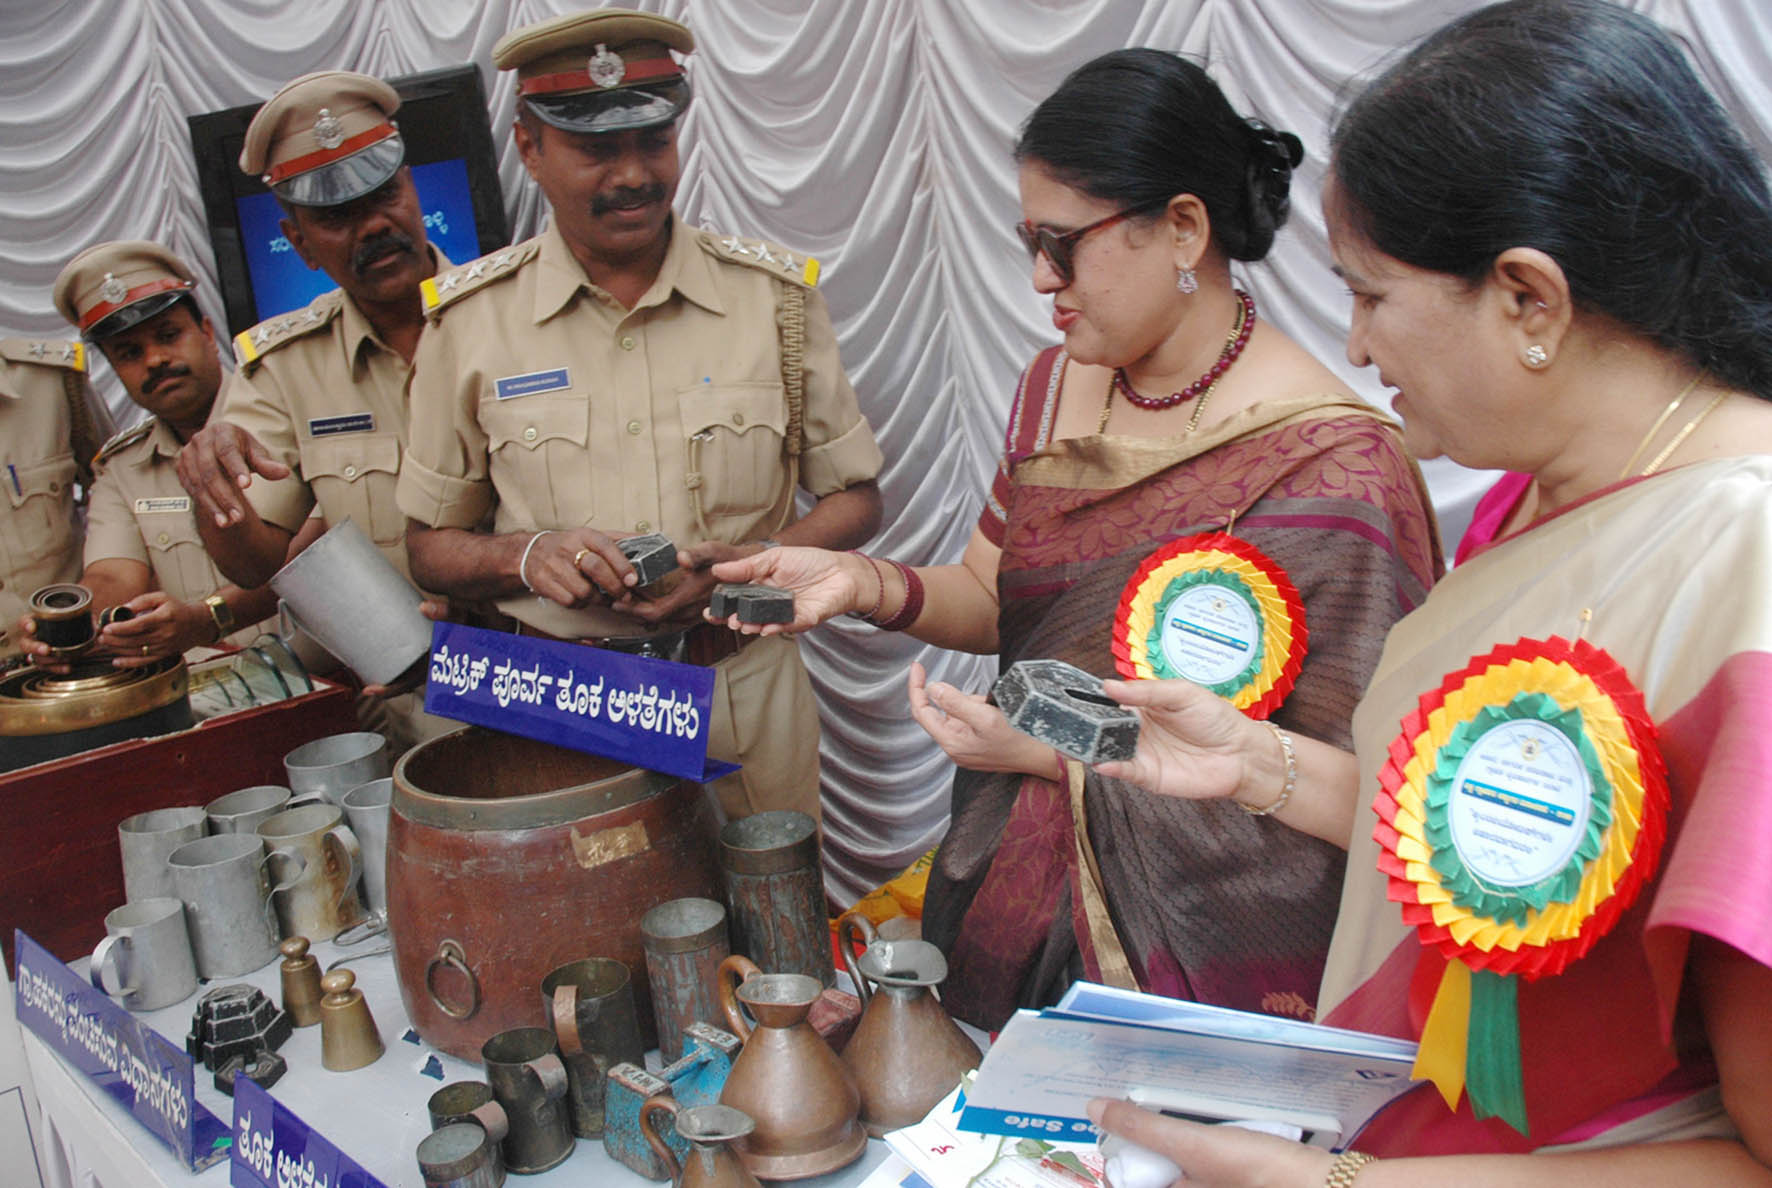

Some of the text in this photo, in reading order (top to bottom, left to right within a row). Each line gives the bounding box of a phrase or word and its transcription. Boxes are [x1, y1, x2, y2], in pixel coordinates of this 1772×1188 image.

[431, 645, 699, 740] ಮೆಟ್ರಿಕ್ ಪೂರ್ವ ತೂಕ ಅಳತೆಗಳು
[238, 1110, 274, 1179] ತೂಕ
[1004, 1115, 1064, 1132] Safe
